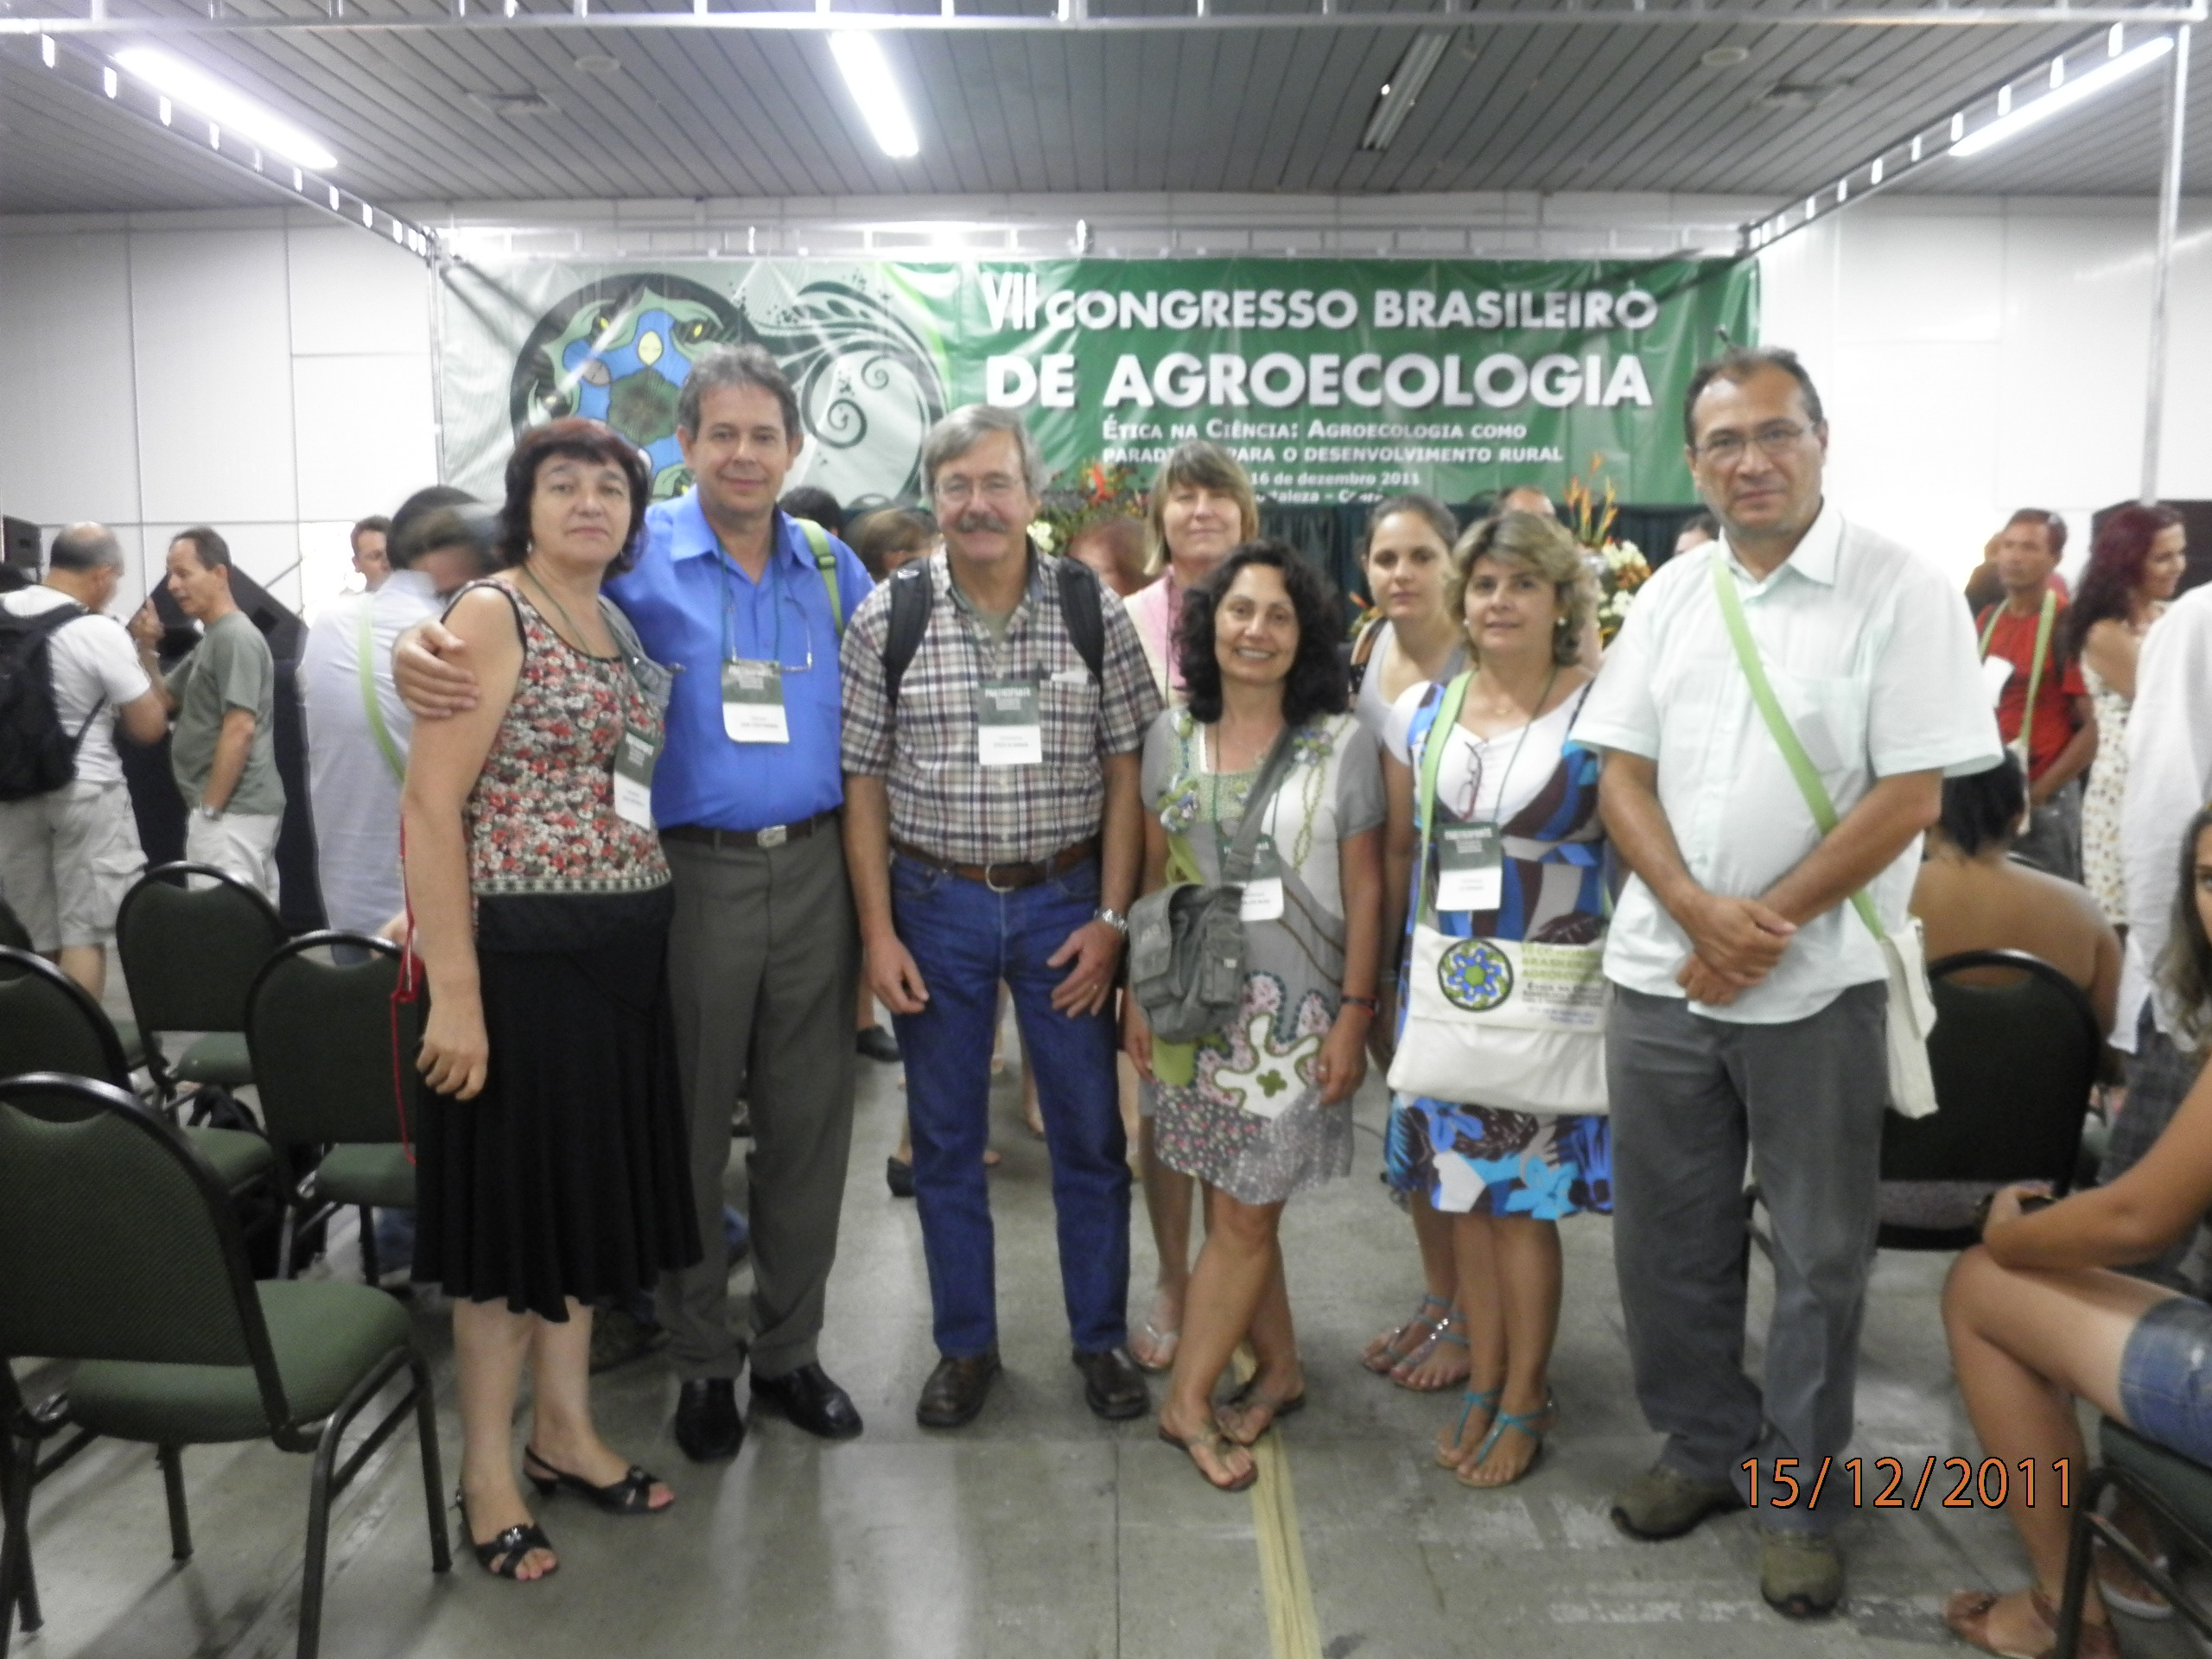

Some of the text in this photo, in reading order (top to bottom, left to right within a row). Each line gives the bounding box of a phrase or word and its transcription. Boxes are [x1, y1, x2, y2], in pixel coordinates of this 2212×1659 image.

[982, 271, 1659, 331] VII CONGRESSO BRASILEIRO
[987, 352, 1653, 408] DE AGROECOLOGIA
[1282, 447, 1298, 463] O
[1304, 447, 1492, 463] DESENVOLVIMENTO
[1498, 447, 1563, 463] RURAL
[1274, 472, 1294, 486] de
[1297, 472, 1376, 486] dezembro
[1381, 472, 1420, 486] 2011
